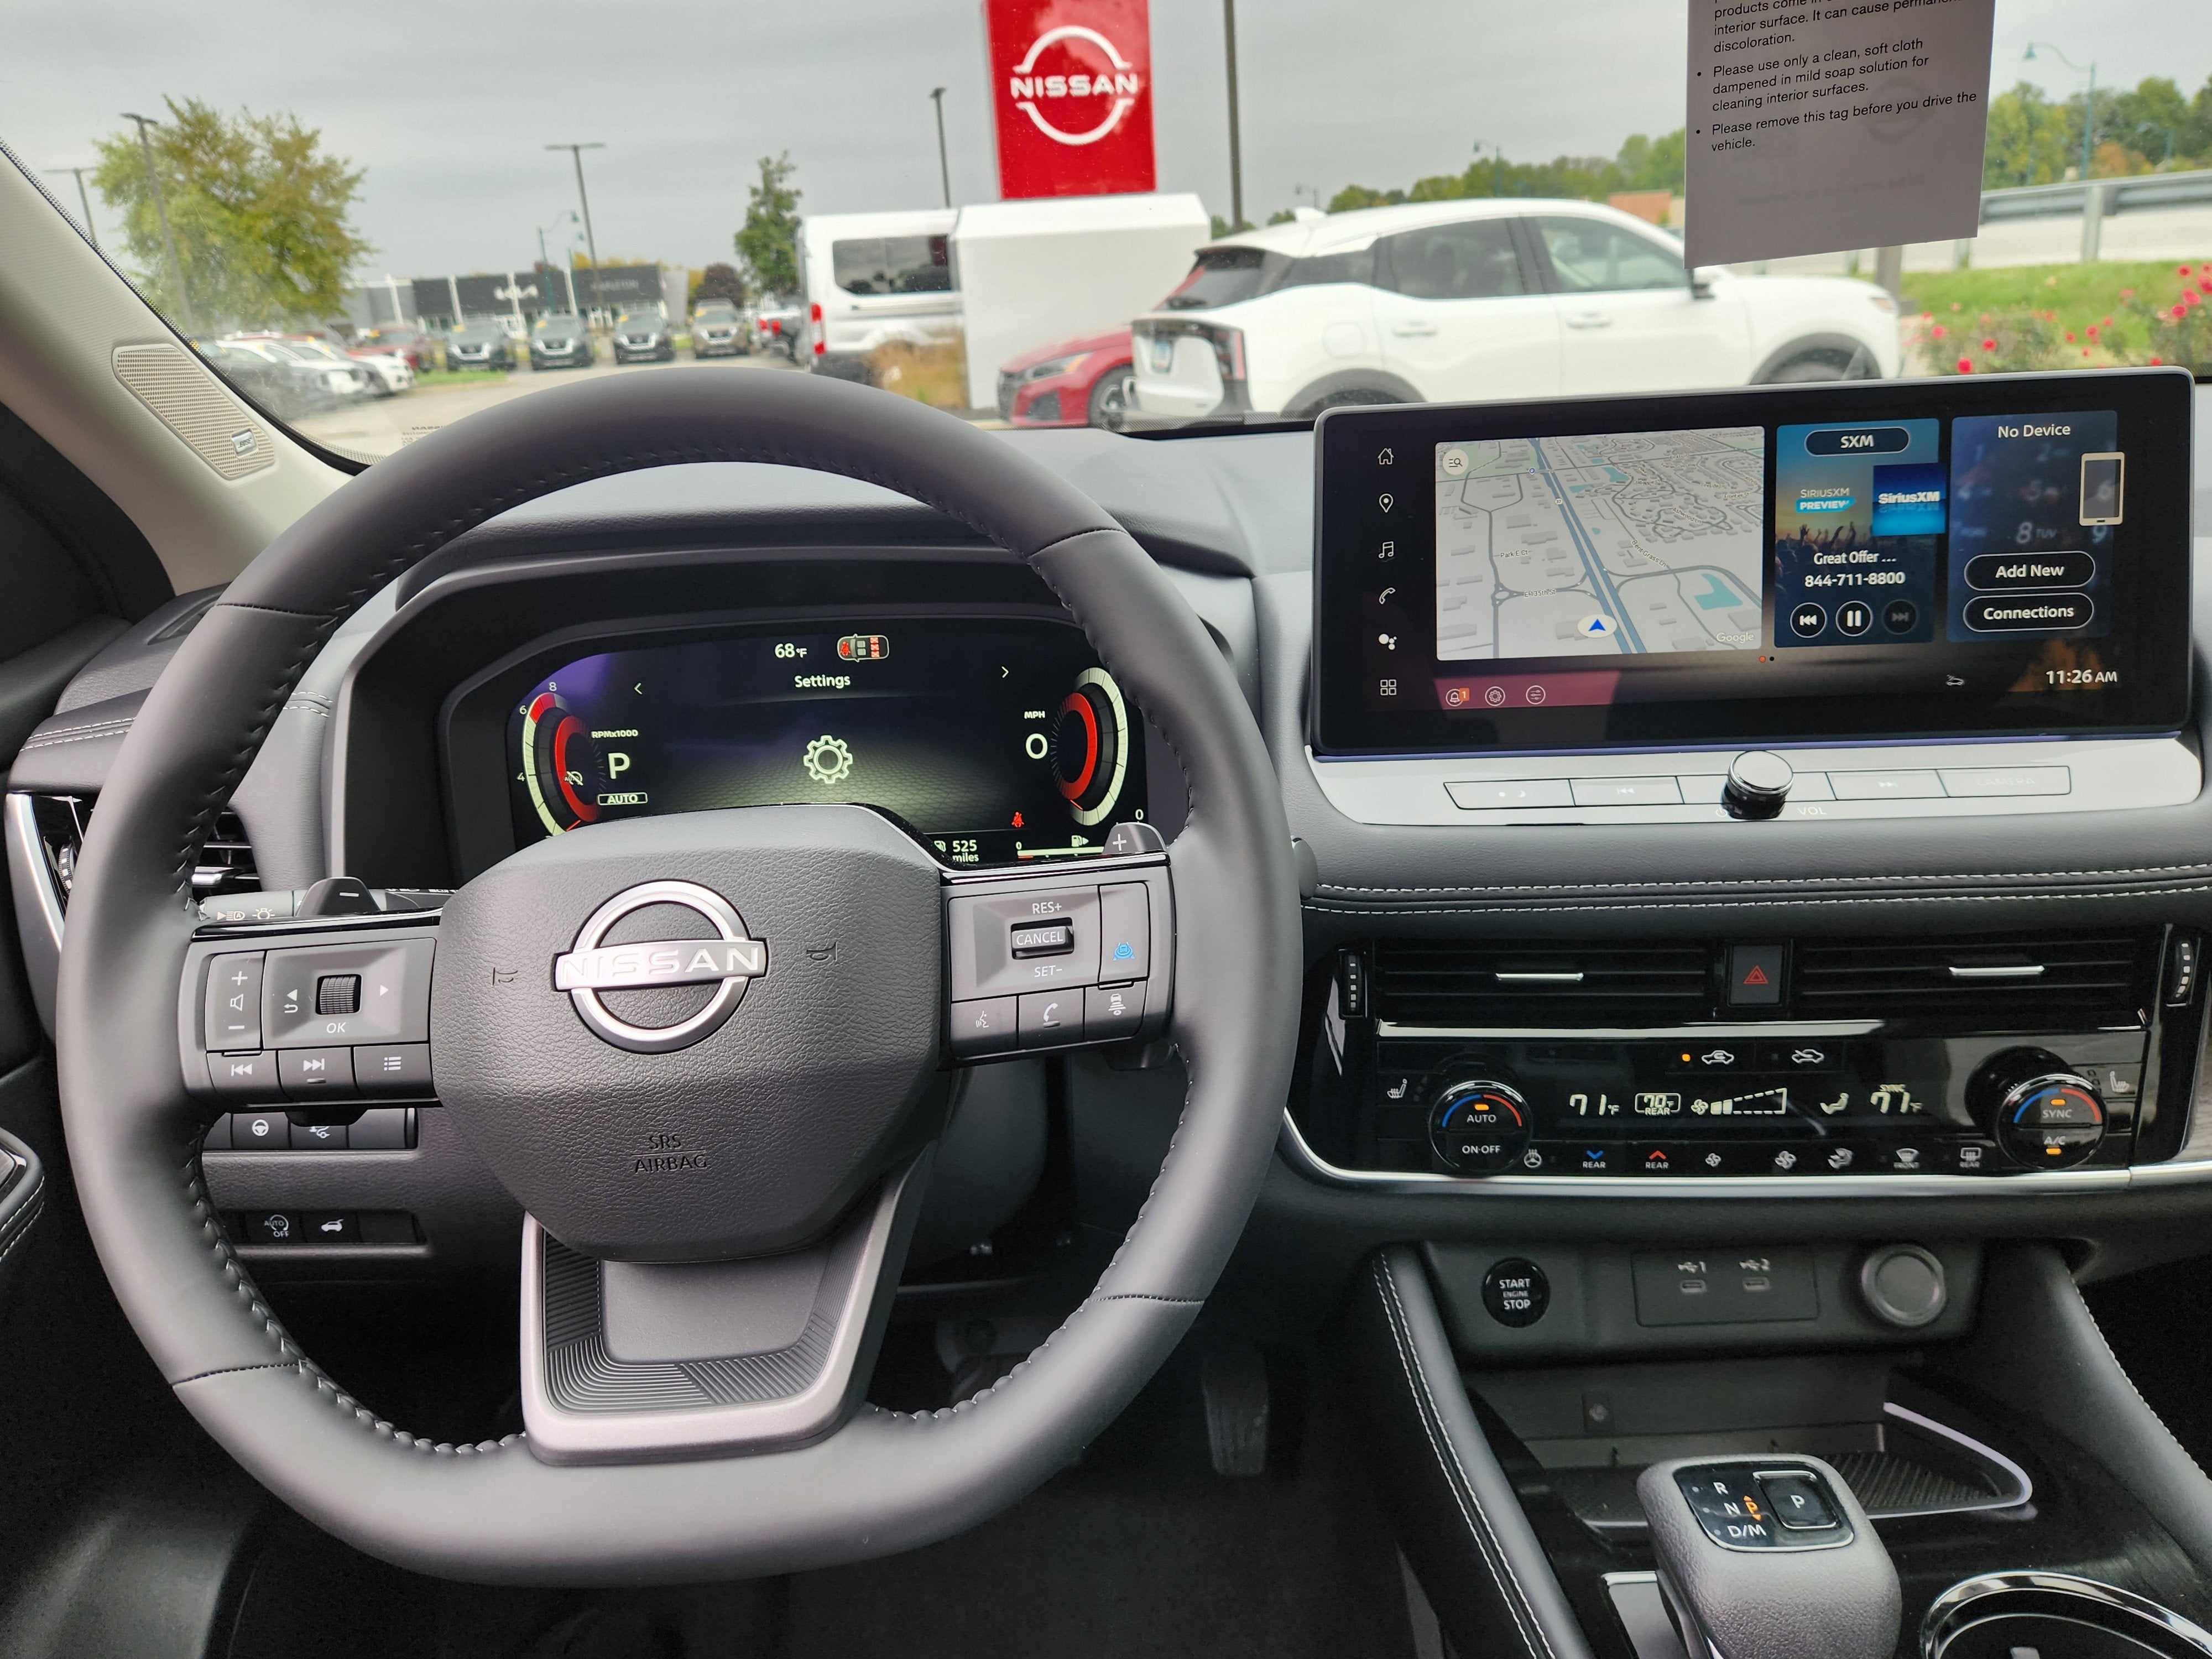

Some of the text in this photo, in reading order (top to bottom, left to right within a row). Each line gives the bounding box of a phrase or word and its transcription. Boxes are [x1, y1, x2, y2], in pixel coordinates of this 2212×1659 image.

[1715, 2, 1768, 21] products
[1714, 20, 1756, 35] interior
[1760, 14, 1808, 28] surface.
[1813, 10, 1820, 21] It
[1825, 8, 1847, 19] can
[1852, 3, 1889, 15] cause
[1714, 33, 1795, 53] discoloration.
[1713, 38, 1923, 77] Please use only a clean, soft cloth
[1713, 55, 1929, 94] dampened in mild soap solution for
[1010, 74, 1138, 98] NISSAN
[1712, 83, 1869, 111] cleaning interior surfaces.
[1712, 91, 1977, 135] Please remove this tag before you drive the
[1712, 137, 1755, 151] vehicle.
[1998, 424, 2070, 439] No Device
[1840, 435, 1874, 448] SXM
[1800, 488, 1850, 498] SIRIUSXM
[1878, 491, 1940, 504] SiriusXM
[1799, 500, 1850, 510] PREVIEW
[1672, 508, 1694, 521] Ashwood
[1632, 540, 1643, 553] Bent
[1643, 551, 1659, 563] Grass
[1814, 552, 1846, 566] Great
[1849, 551, 1880, 564] Offer
[1995, 564, 2064, 579] Add New
[1804, 572, 1905, 588] 844-711-8800
[1983, 606, 2074, 621] Connections
[1717, 632, 1754, 644] Google
[795, 675, 851, 688] Settings
[2046, 669, 2117, 685] 11:26 AM
[549, 682, 557, 691] 8
[519, 706, 526, 714] 6
[1024, 711, 1045, 719] MPH
[592, 729, 638, 739] RPMx1000
[608, 753, 630, 780] P
[517, 773, 525, 781] 4
[608, 794, 638, 803] AUTO
[1135, 809, 1144, 821] 0
[1797, 806, 1827, 816] VOL
[952, 840, 977, 852] 525
[952, 853, 979, 862] miles
[1032, 902, 1062, 914] RES+
[1016, 932, 1063, 946] CANCEL
[561, 947, 758, 984] NISSAN
[326, 1022, 347, 1034] OK
[1645, 1107, 1671, 1115] REAR
[2043, 1109, 2072, 1119] SYNC
[1467, 1114, 1496, 1124] AUTO
[649, 1134, 681, 1150] SRS
[2043, 1136, 2065, 1146] A/C
[635, 1154, 707, 1173] AIRBAG
[1499, 1278, 1530, 1289] START
[1504, 1299, 1531, 1310] STOP
[1713, 1482, 1729, 1495] R
[1790, 1495, 1805, 1509] P
[1724, 1502, 1759, 1516] N P
[1726, 1524, 1767, 1538] D/M
